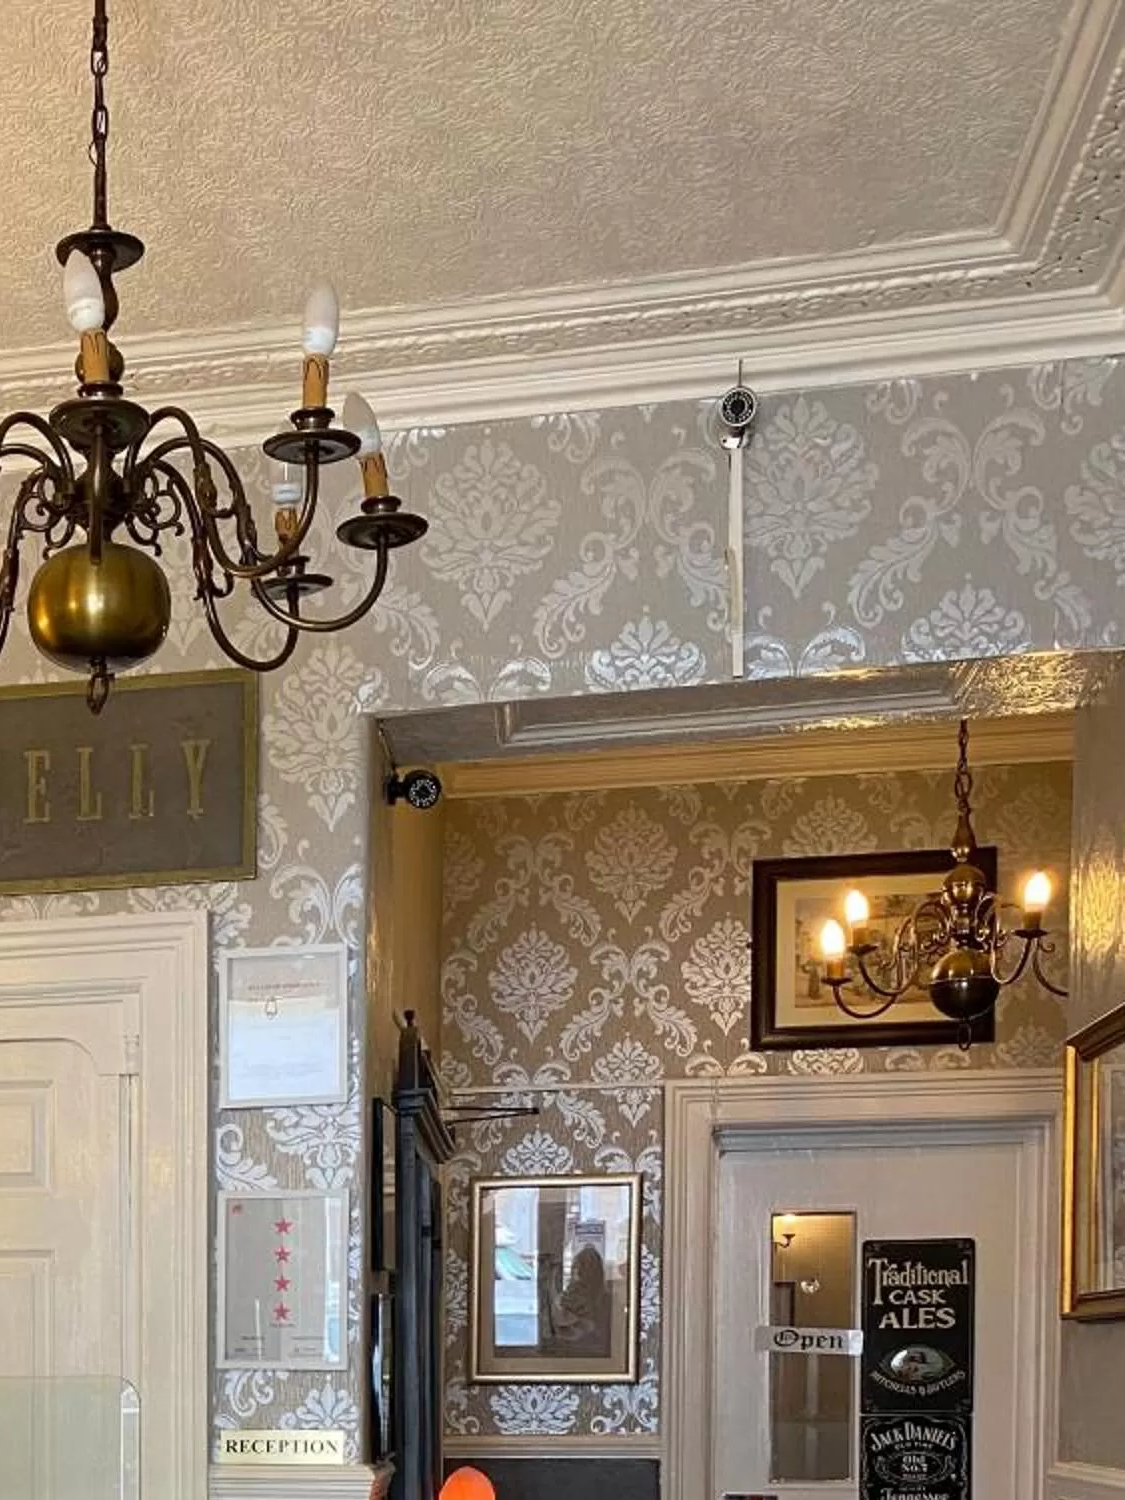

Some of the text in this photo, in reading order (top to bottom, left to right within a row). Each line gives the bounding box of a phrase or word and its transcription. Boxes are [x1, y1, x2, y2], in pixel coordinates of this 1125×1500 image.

[867, 1257, 969, 1306] Traditional
[888, 1289, 947, 1305] CASK
[878, 1307, 956, 1329] ALES
[774, 1329, 843, 1350] Open
[225, 1438, 338, 1454] RECEPTION
[871, 1428, 905, 1452] JACK
